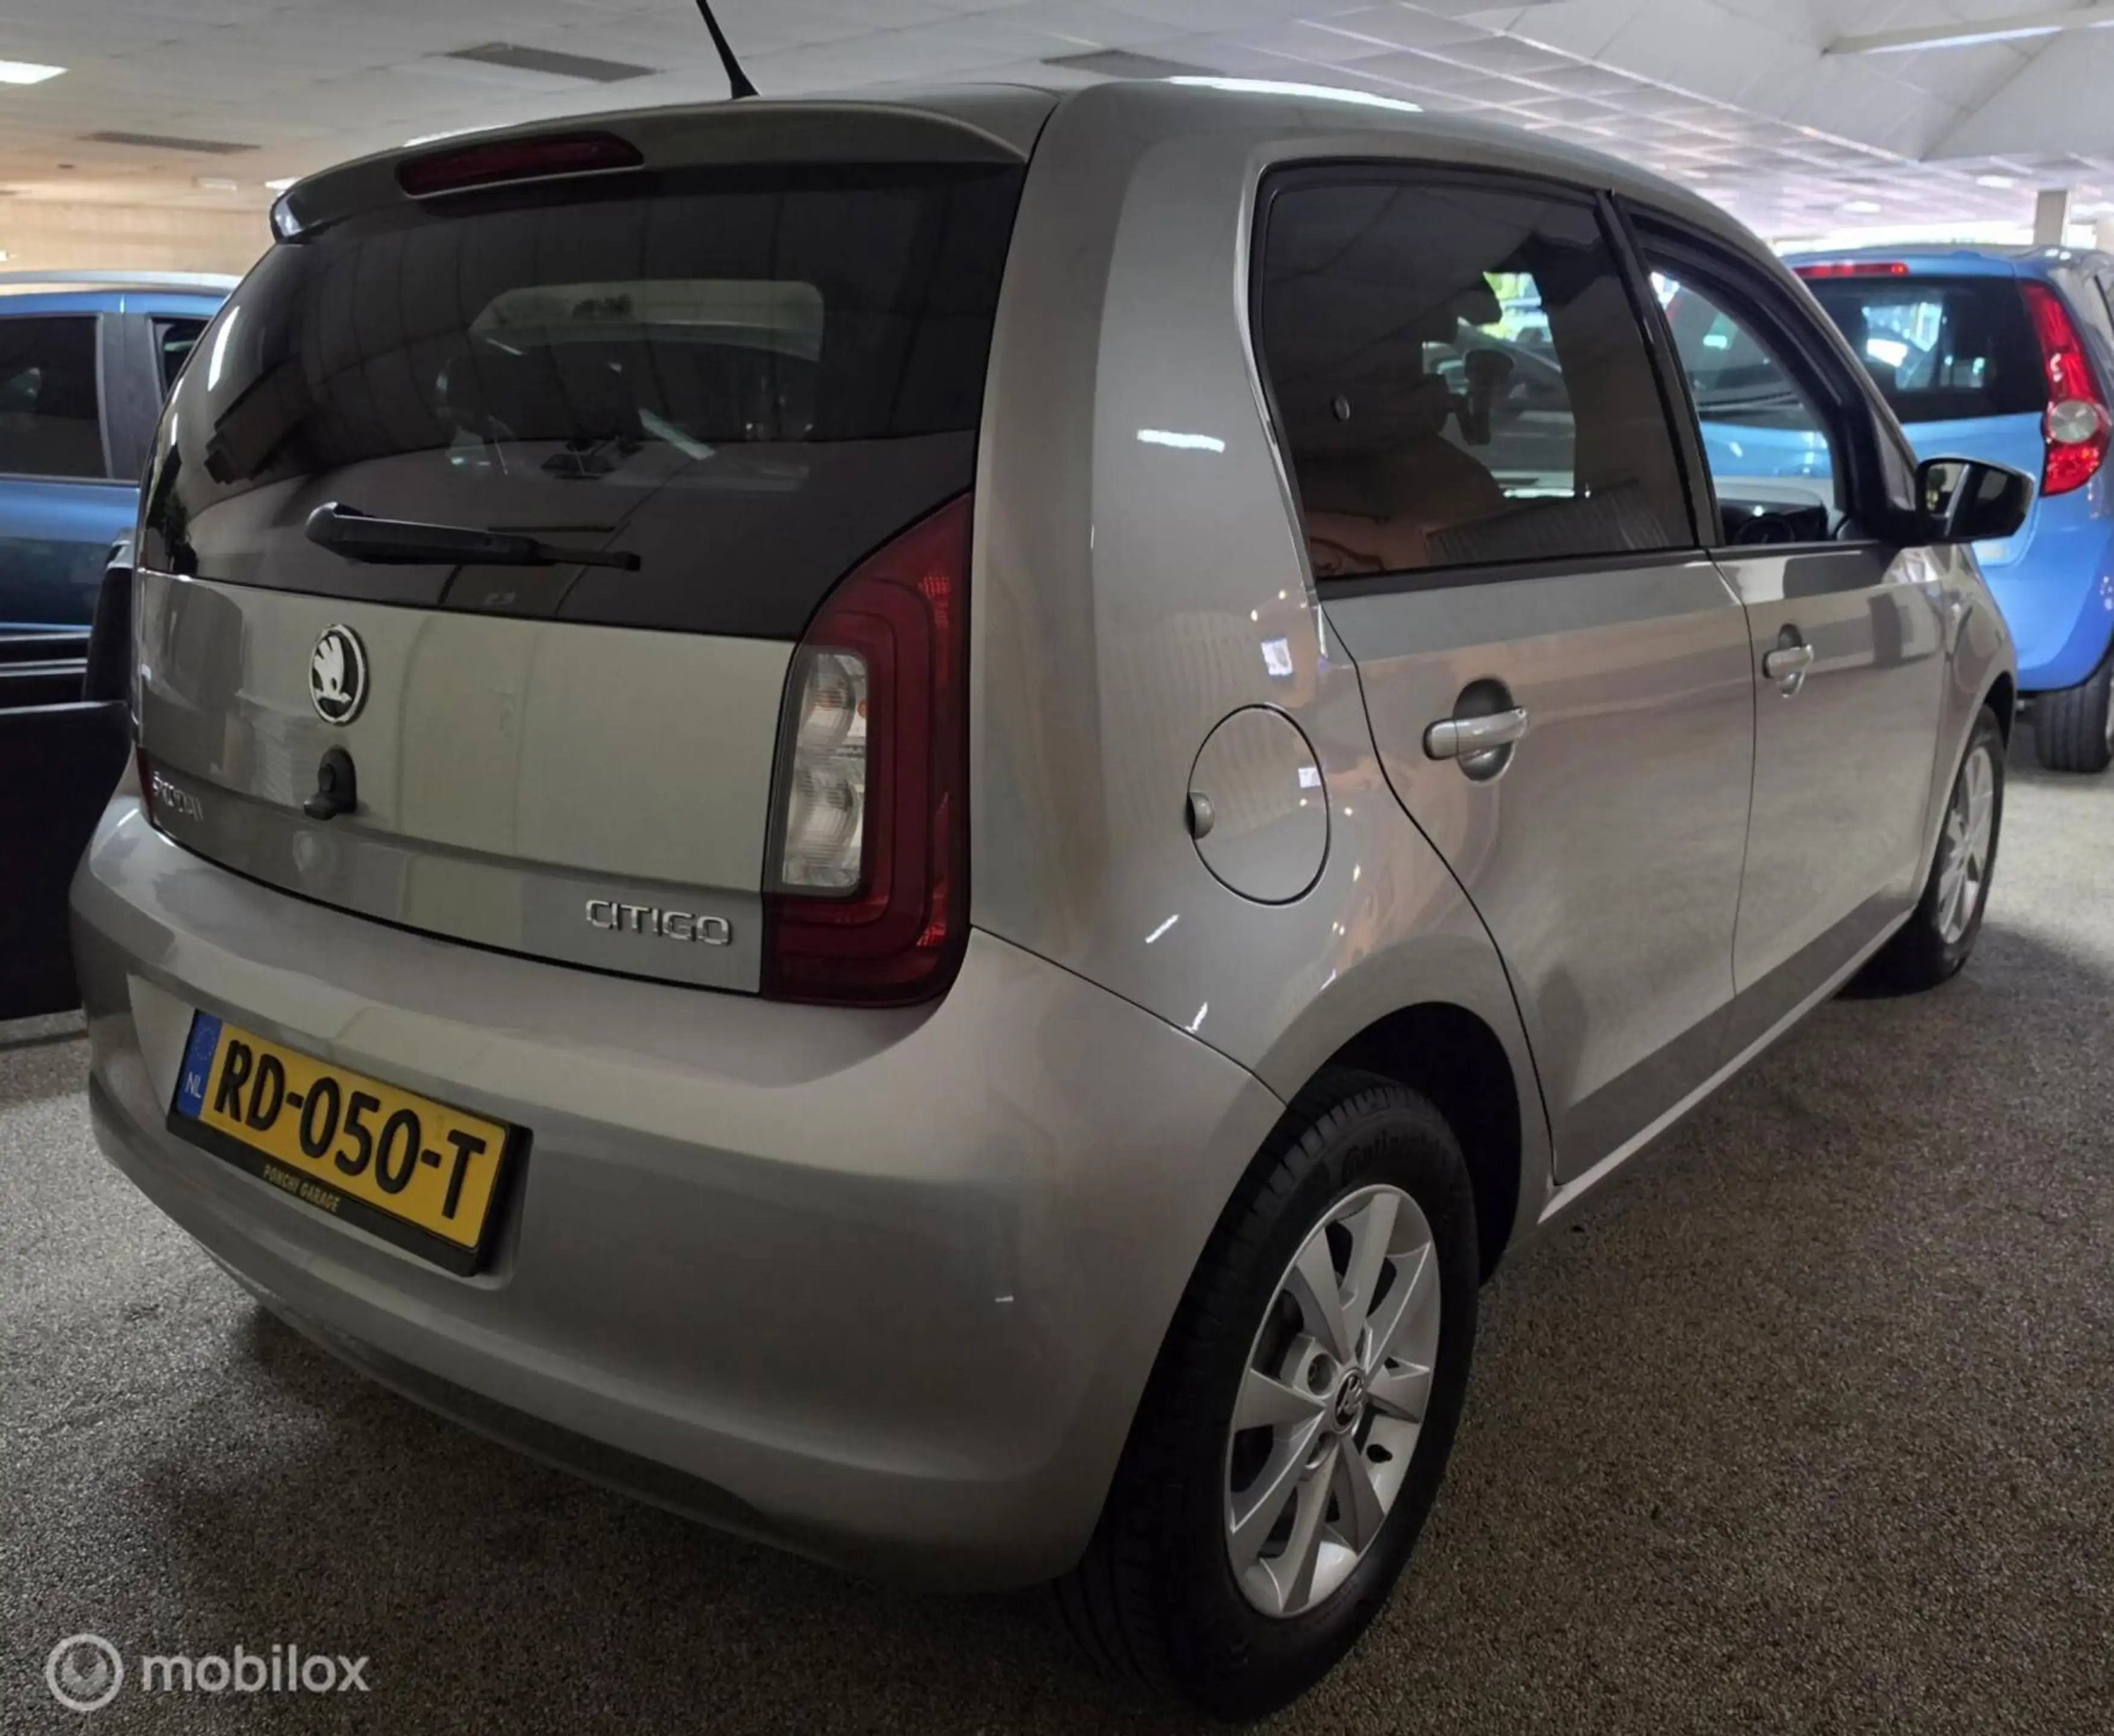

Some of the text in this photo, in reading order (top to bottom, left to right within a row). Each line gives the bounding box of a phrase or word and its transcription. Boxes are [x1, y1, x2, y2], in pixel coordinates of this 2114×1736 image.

[585, 899, 730, 945] CITIGO
[184, 1071, 203, 1099] NL
[213, 1039, 486, 1219] RD-050-T
